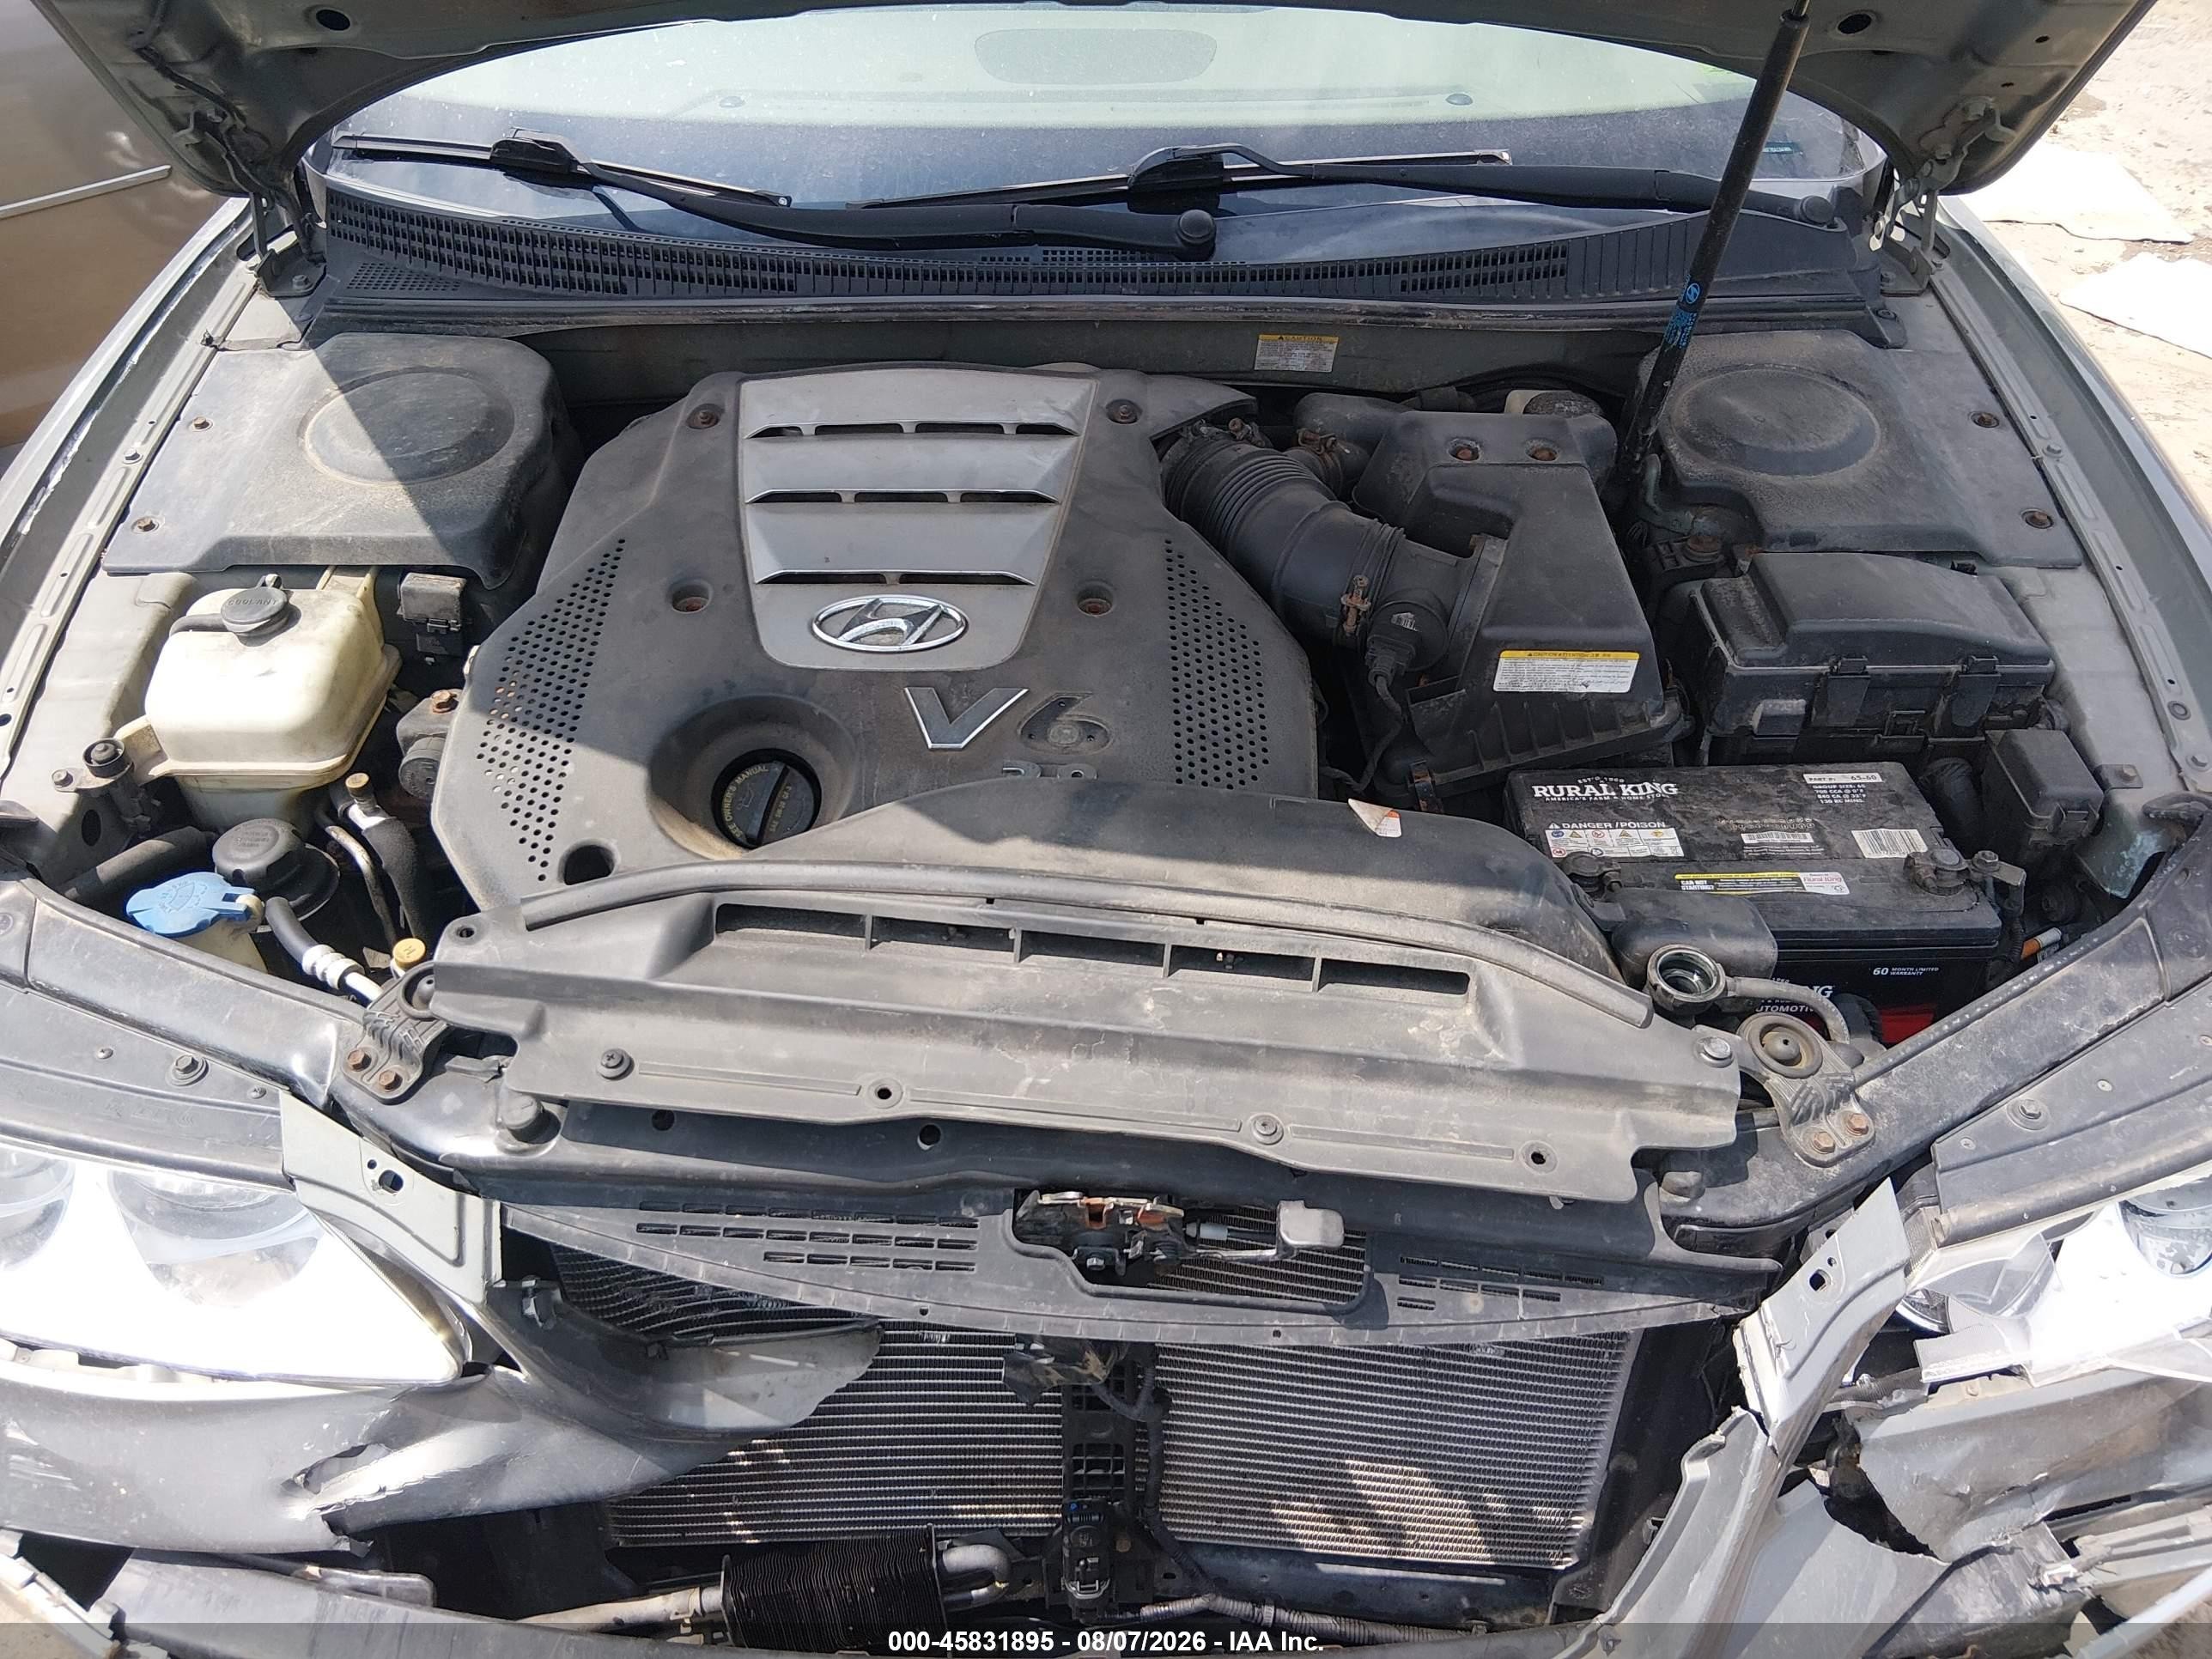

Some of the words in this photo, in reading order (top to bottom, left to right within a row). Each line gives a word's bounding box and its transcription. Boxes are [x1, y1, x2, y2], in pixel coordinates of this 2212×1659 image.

[735, 765, 769, 784] MANUAL
[1531, 783, 1616, 798] RURAL
[1618, 782, 1679, 796] KING
[1873, 967, 1889, 975] 60
